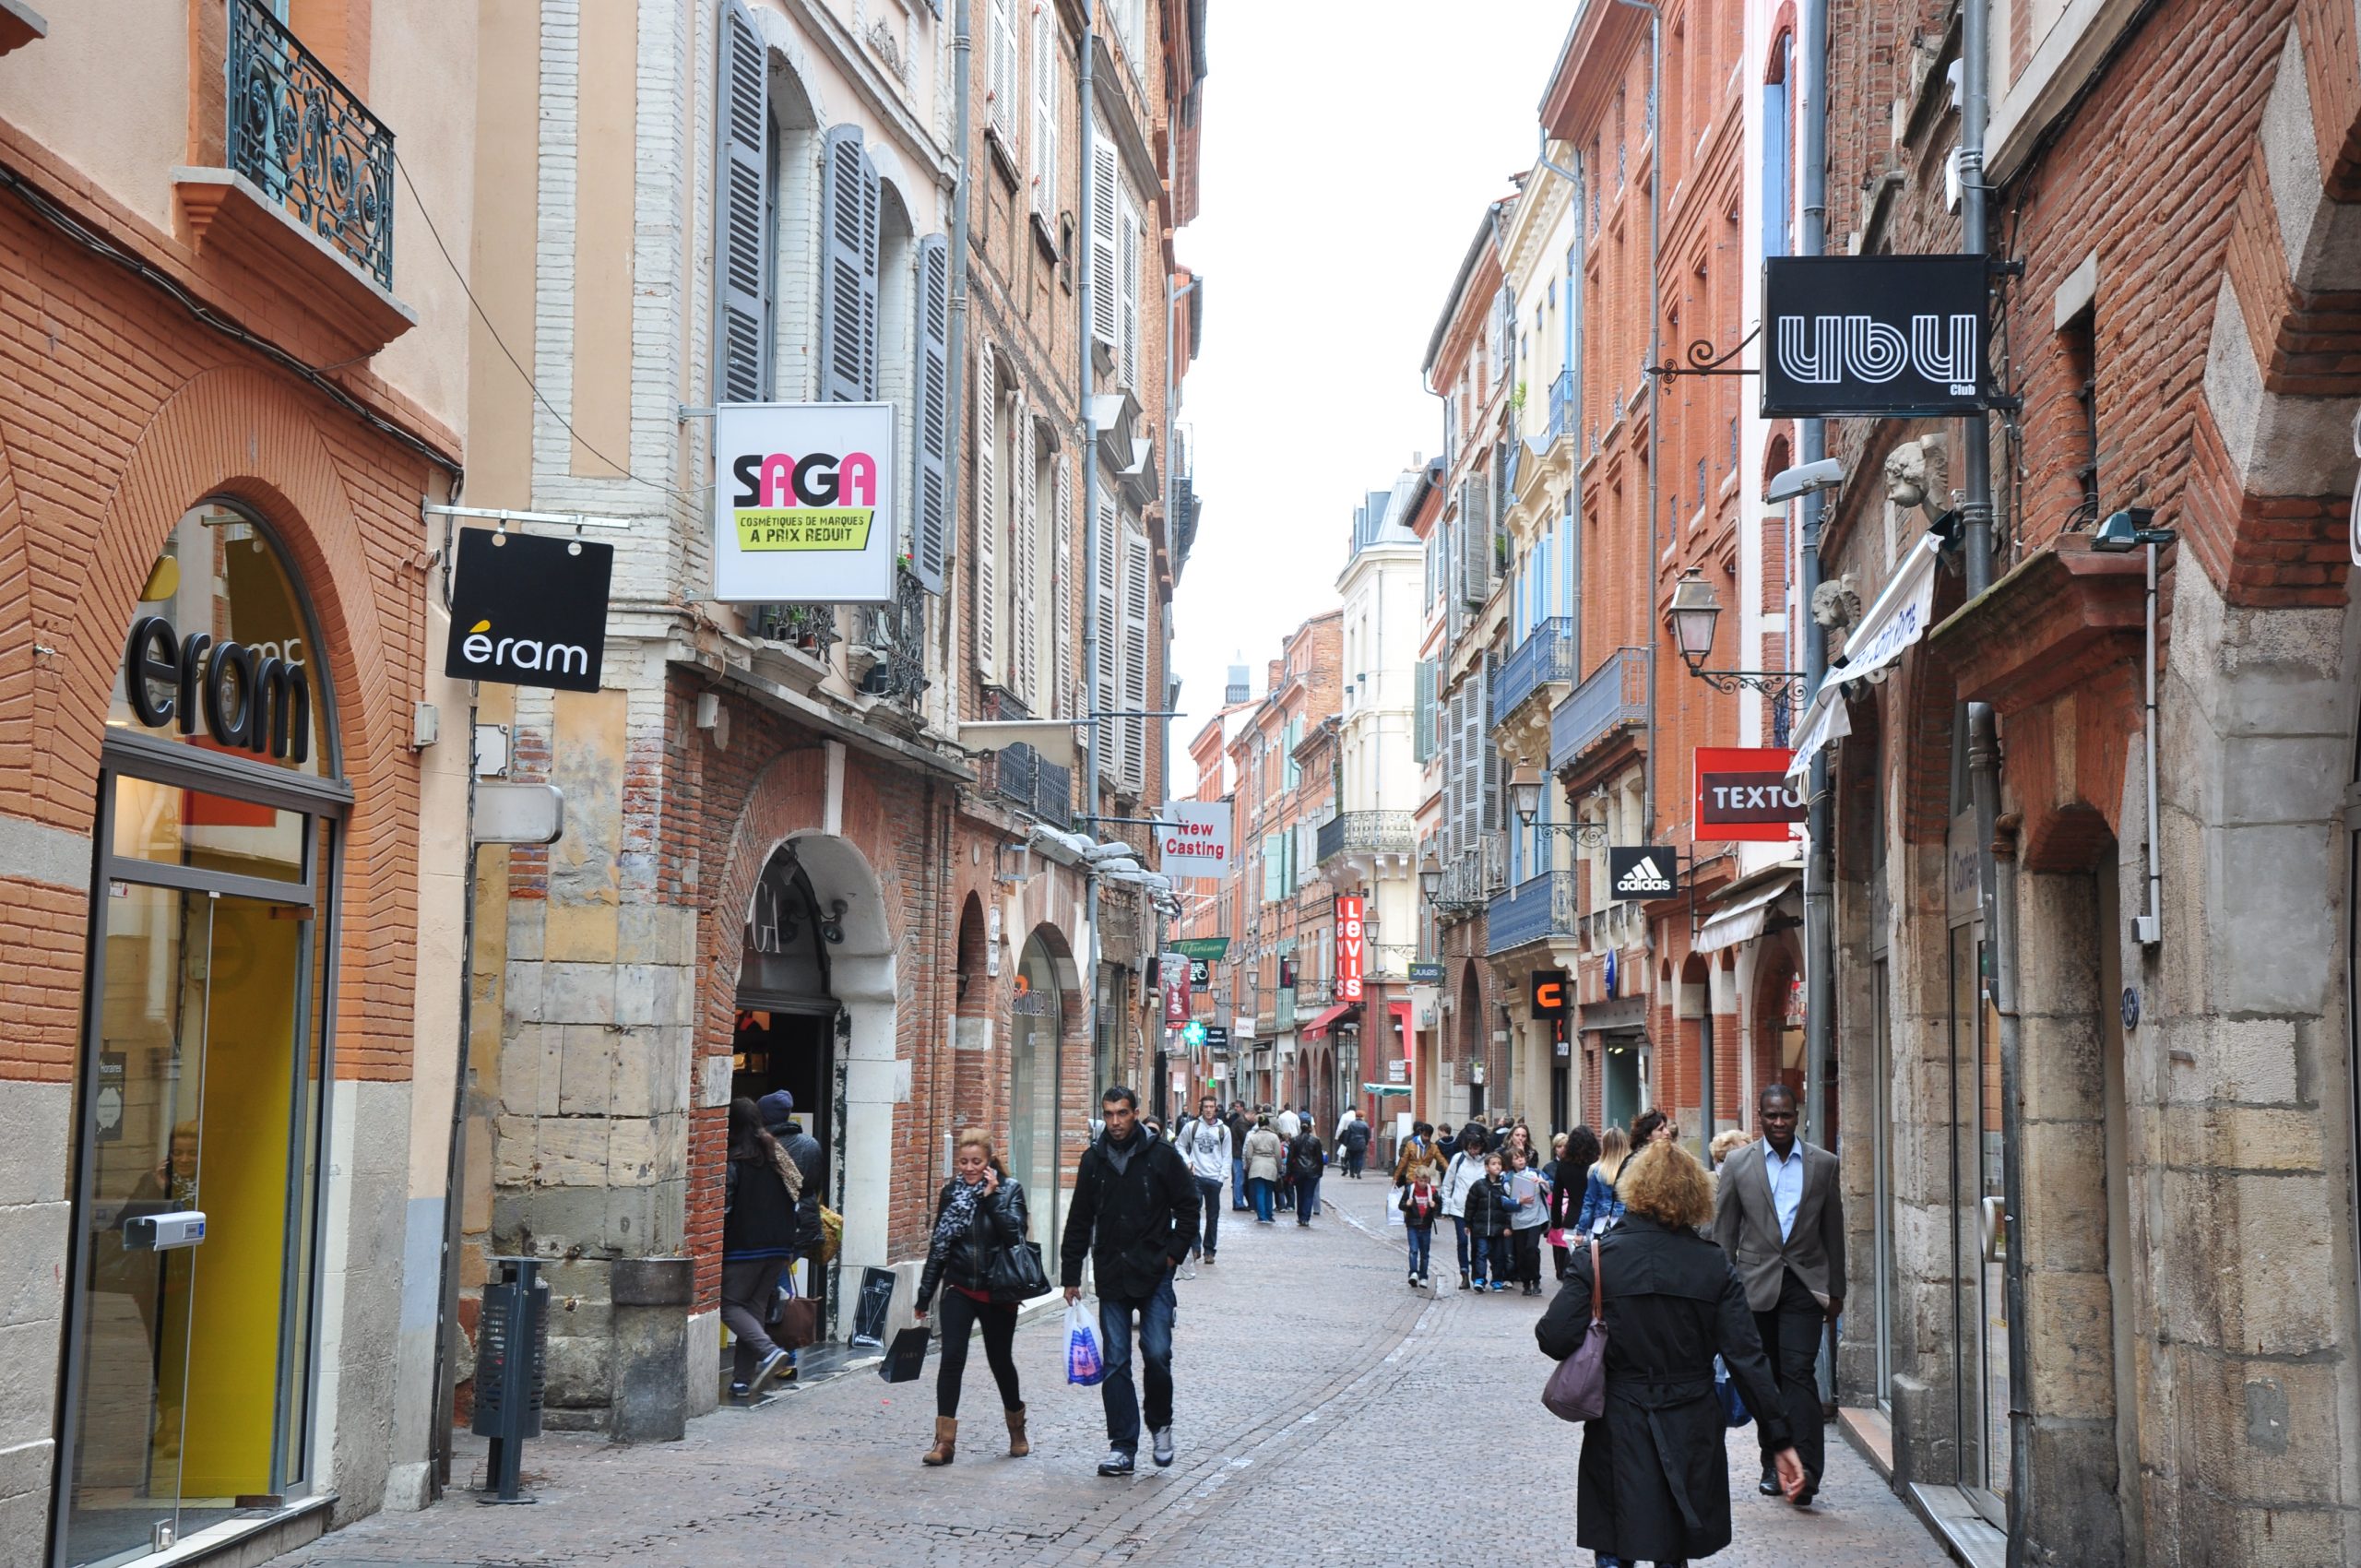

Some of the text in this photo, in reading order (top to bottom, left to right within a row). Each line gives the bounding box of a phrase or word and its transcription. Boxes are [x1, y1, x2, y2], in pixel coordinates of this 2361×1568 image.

[1778, 315, 1977, 384] ubu
[1950, 383, 1975, 396] Club
[733, 452, 876, 507] SAGA
[741, 515, 864, 527] COSMÉTIQUES DE MARQUES
[750, 528, 852, 542] A PRIX REDUIT
[463, 619, 588, 675] éram
[1177, 820, 1214, 837] New
[1166, 838, 1225, 860] Casting
[1617, 878, 1671, 892] adidas
[749, 880, 782, 954] GA
[2123, 993, 2134, 1022] 16
